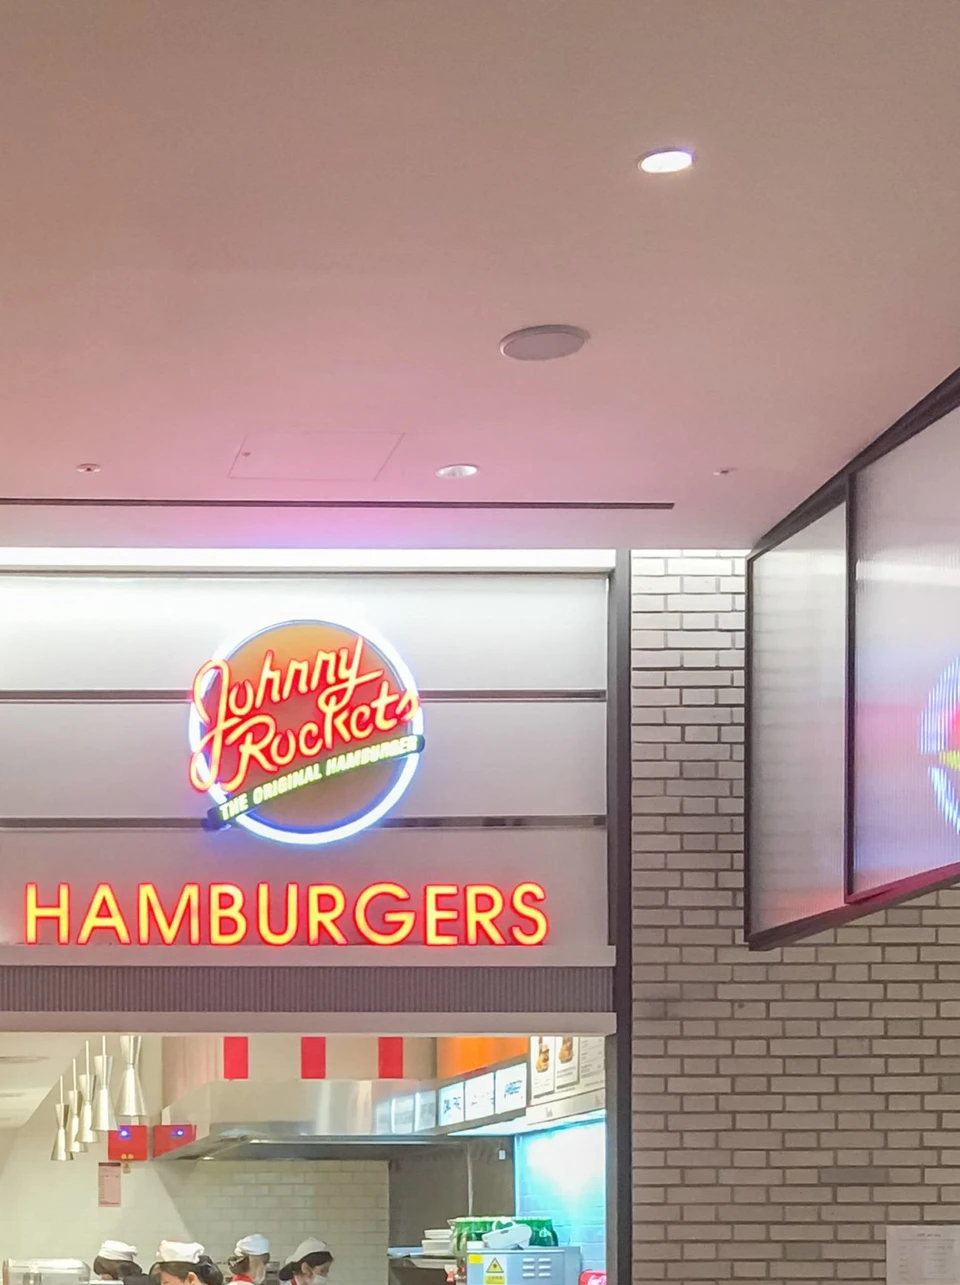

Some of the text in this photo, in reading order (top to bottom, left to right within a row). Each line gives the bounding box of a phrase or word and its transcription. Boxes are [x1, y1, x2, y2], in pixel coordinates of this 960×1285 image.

[191, 636, 384, 793] Johnny
[221, 680, 422, 792] Rockets
[219, 735, 419, 821] THE ORIGINAL HAMBURGER
[23, 881, 551, 946] HAMBURGERS
